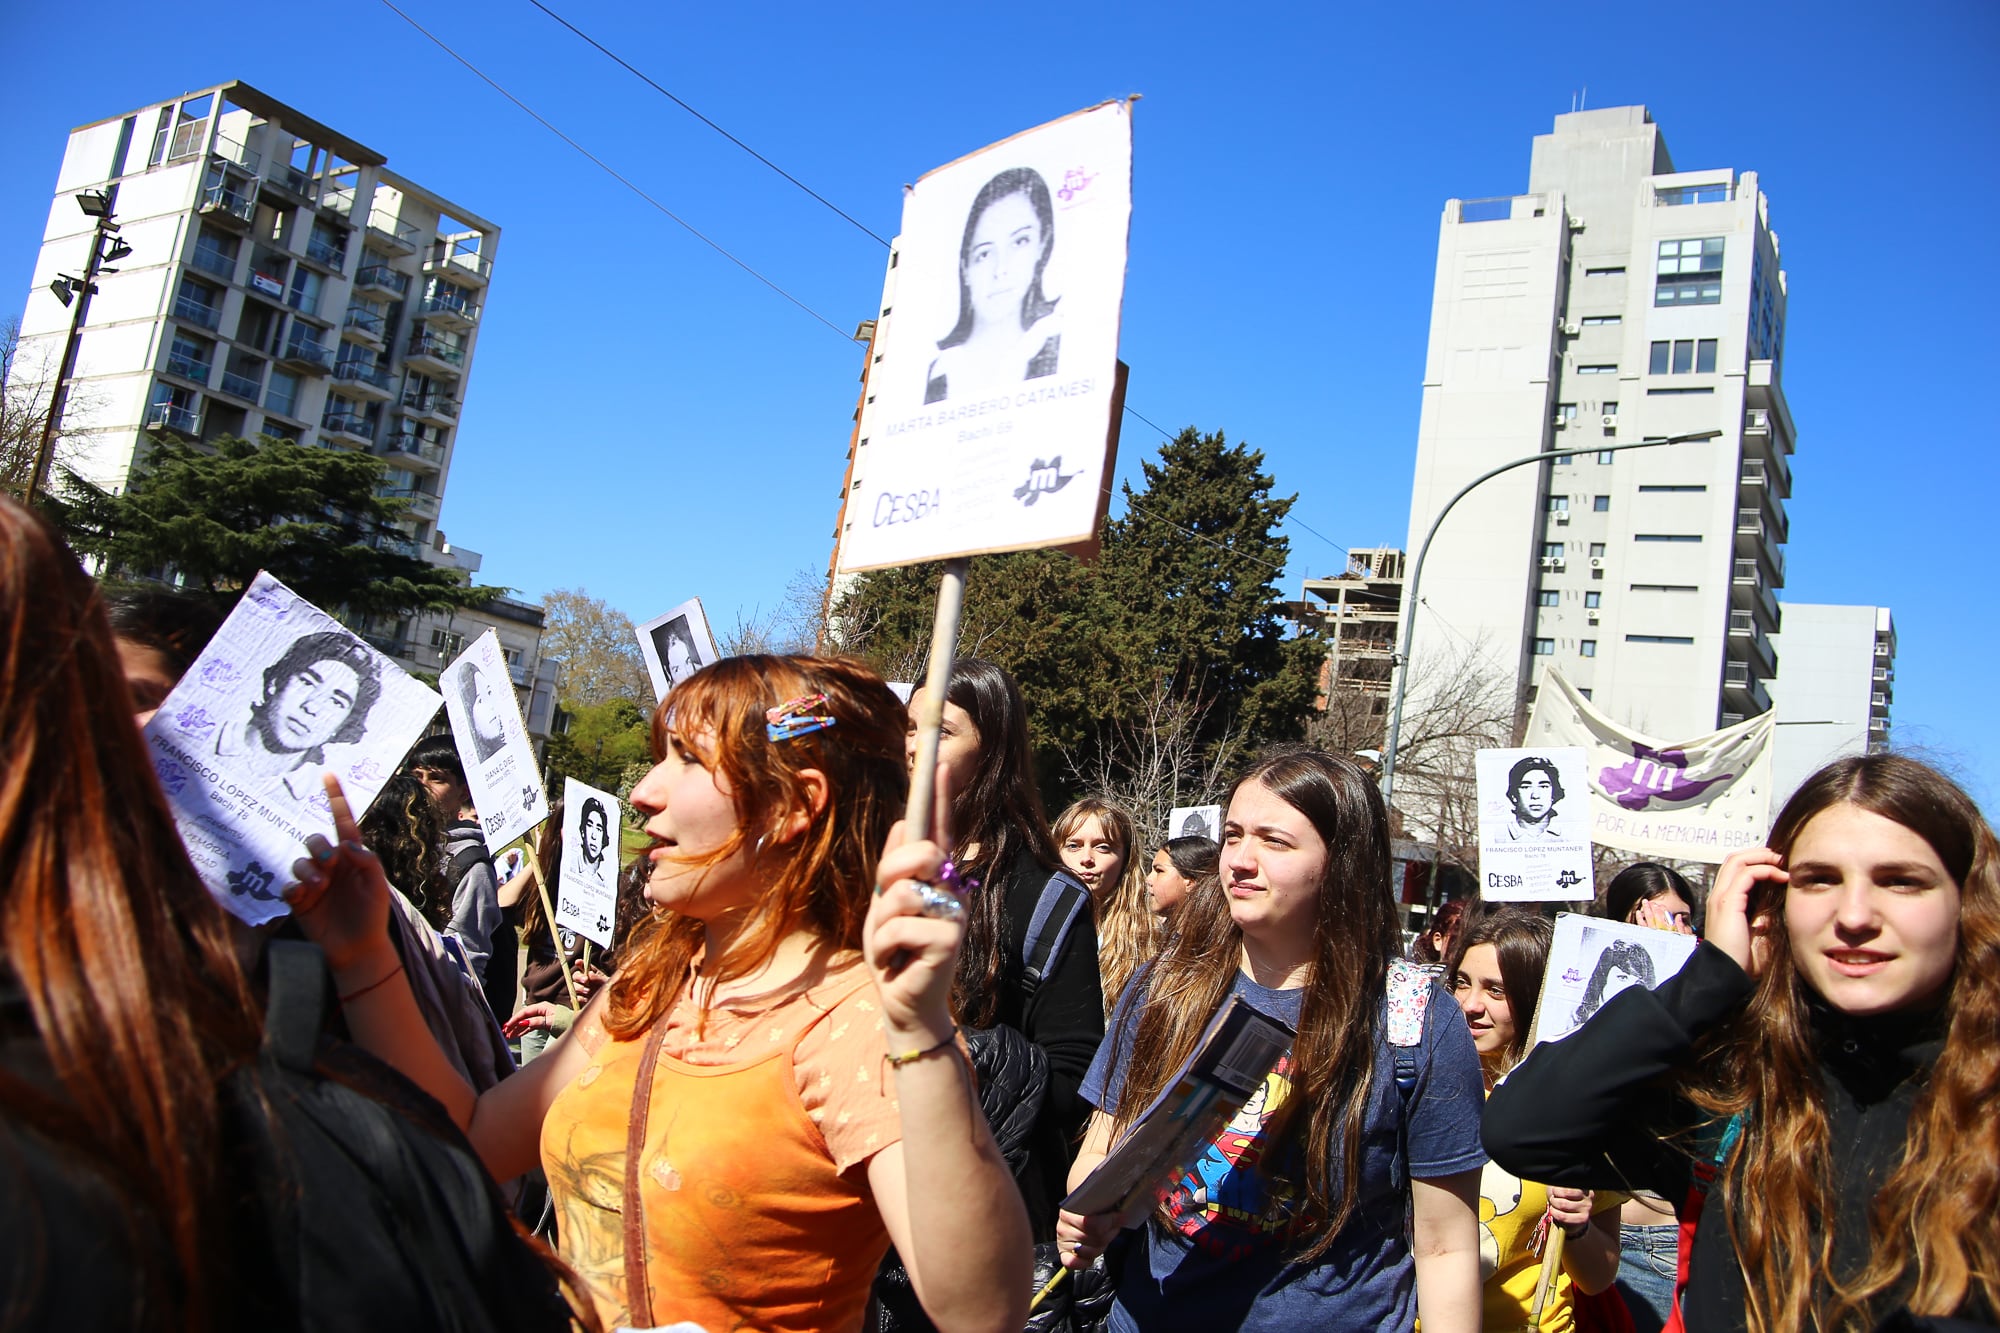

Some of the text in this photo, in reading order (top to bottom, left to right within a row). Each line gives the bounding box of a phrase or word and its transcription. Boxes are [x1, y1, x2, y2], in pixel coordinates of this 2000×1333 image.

[886, 378, 1096, 437] MARTA BARBERO CATANESI
[151, 734, 219, 784] FRANCISCO
[218, 778, 258, 811] LÓPEZ
[210, 791, 236, 812] Bachi
[1596, 813, 1751, 848] POR LA MEMORIA BBA
[1488, 872, 1523, 888] CESBA
